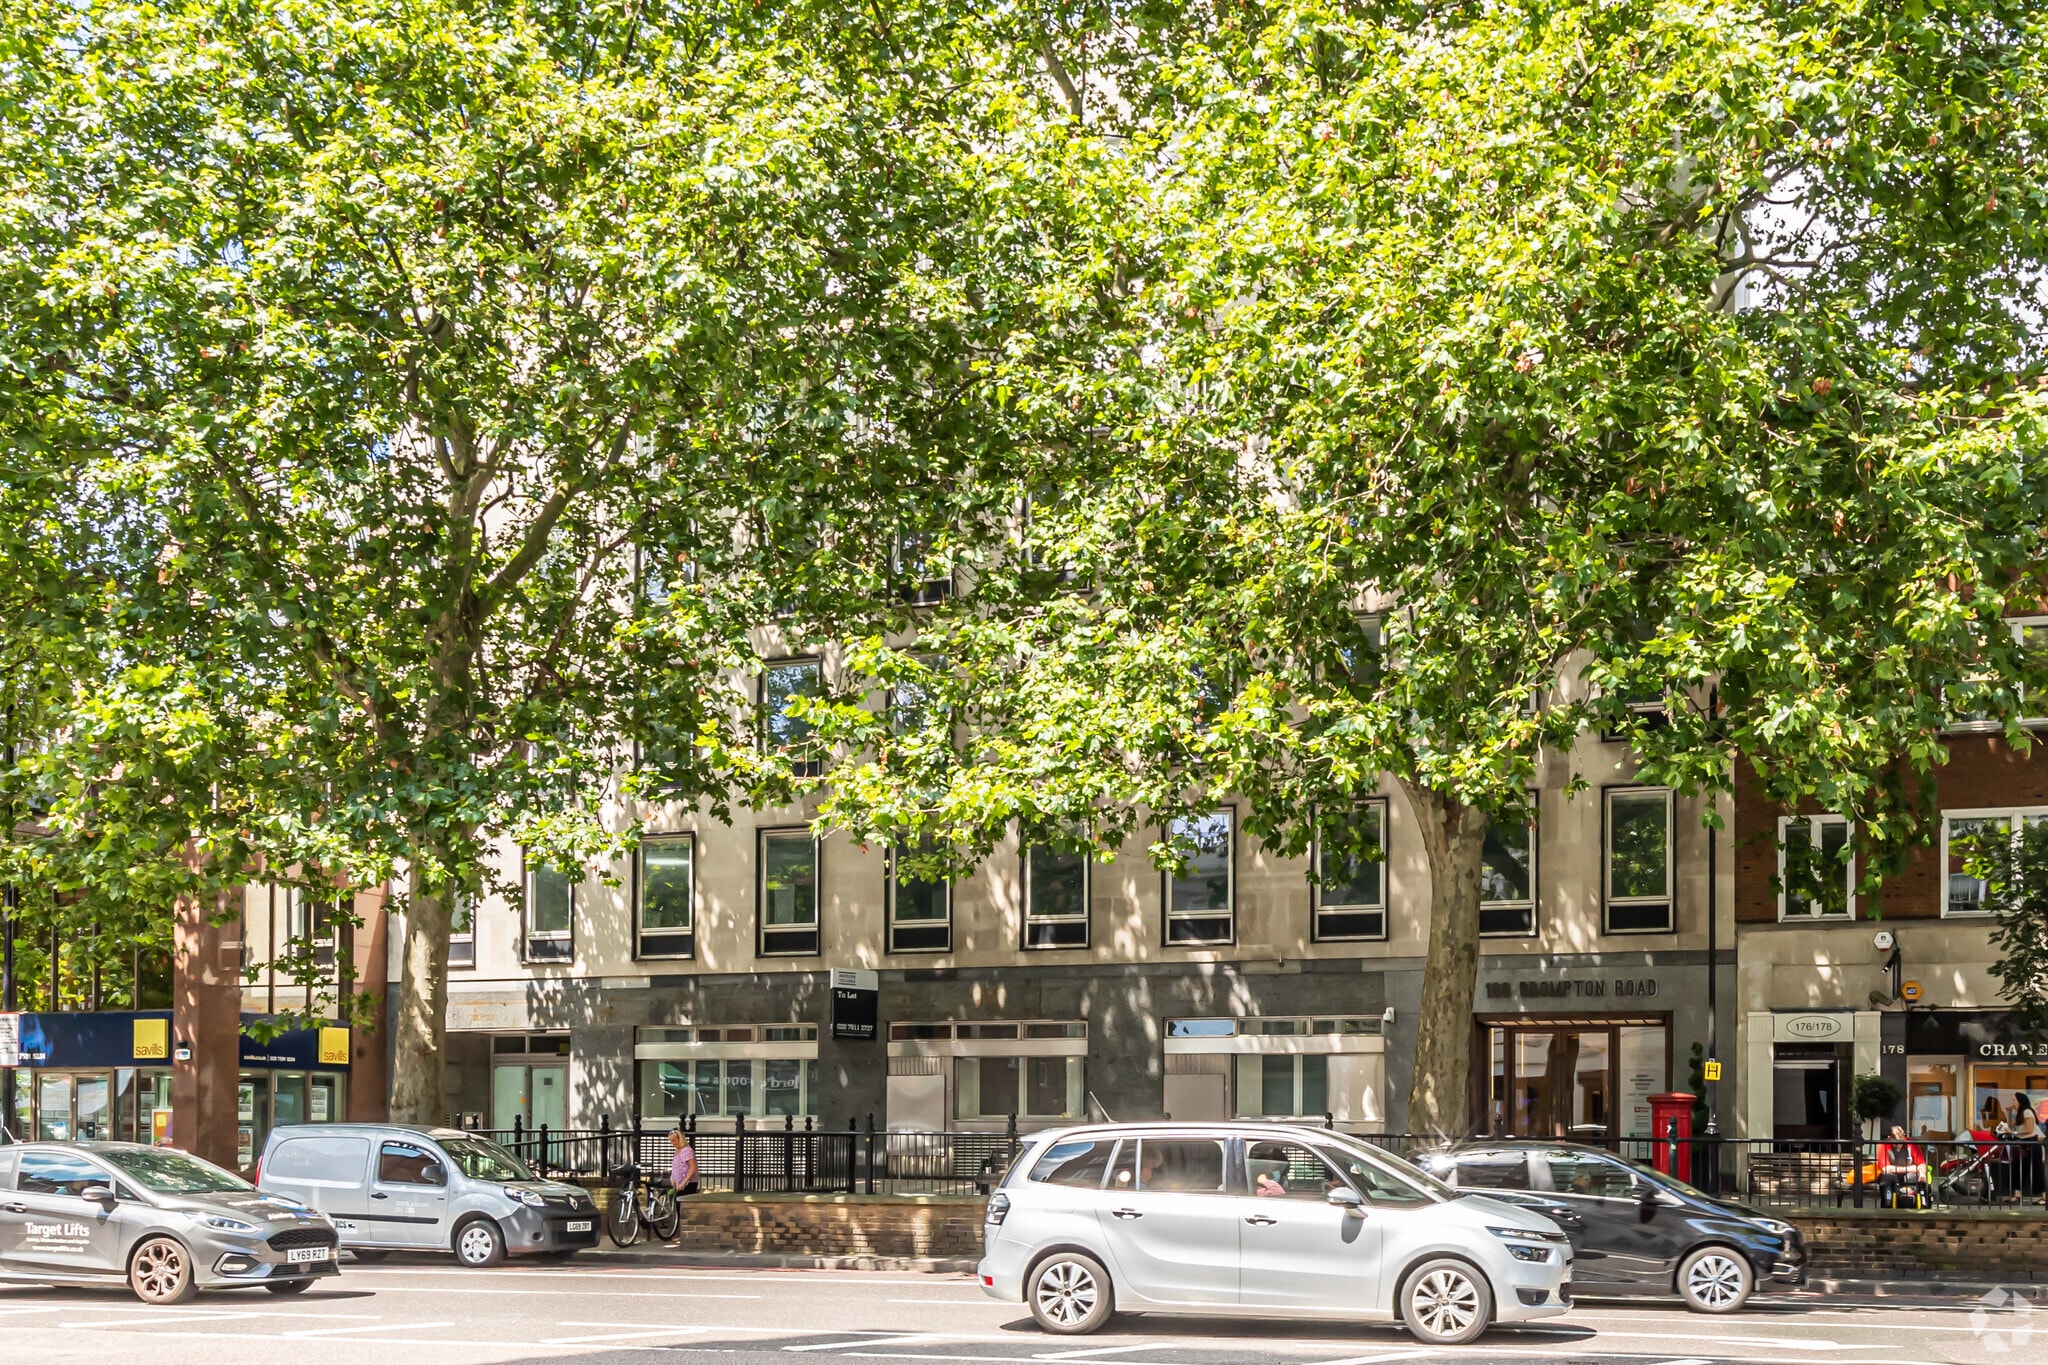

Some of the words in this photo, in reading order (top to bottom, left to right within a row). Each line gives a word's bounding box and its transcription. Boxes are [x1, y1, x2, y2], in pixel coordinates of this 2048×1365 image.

[1519, 980, 1606, 998] BROMPTON
[1615, 979, 1657, 997] ROAD
[1795, 1022, 1832, 1031] 176/178
[135, 1044, 163, 1056] savills
[1882, 1045, 1905, 1054] 178
[323, 1050, 348, 1062] savills
[1707, 1064, 1719, 1078] H
[25, 1222, 62, 1237] Target
[64, 1224, 90, 1237] Lifts
[291, 1251, 312, 1261] LY69
[312, 1249, 326, 1259] RZT
